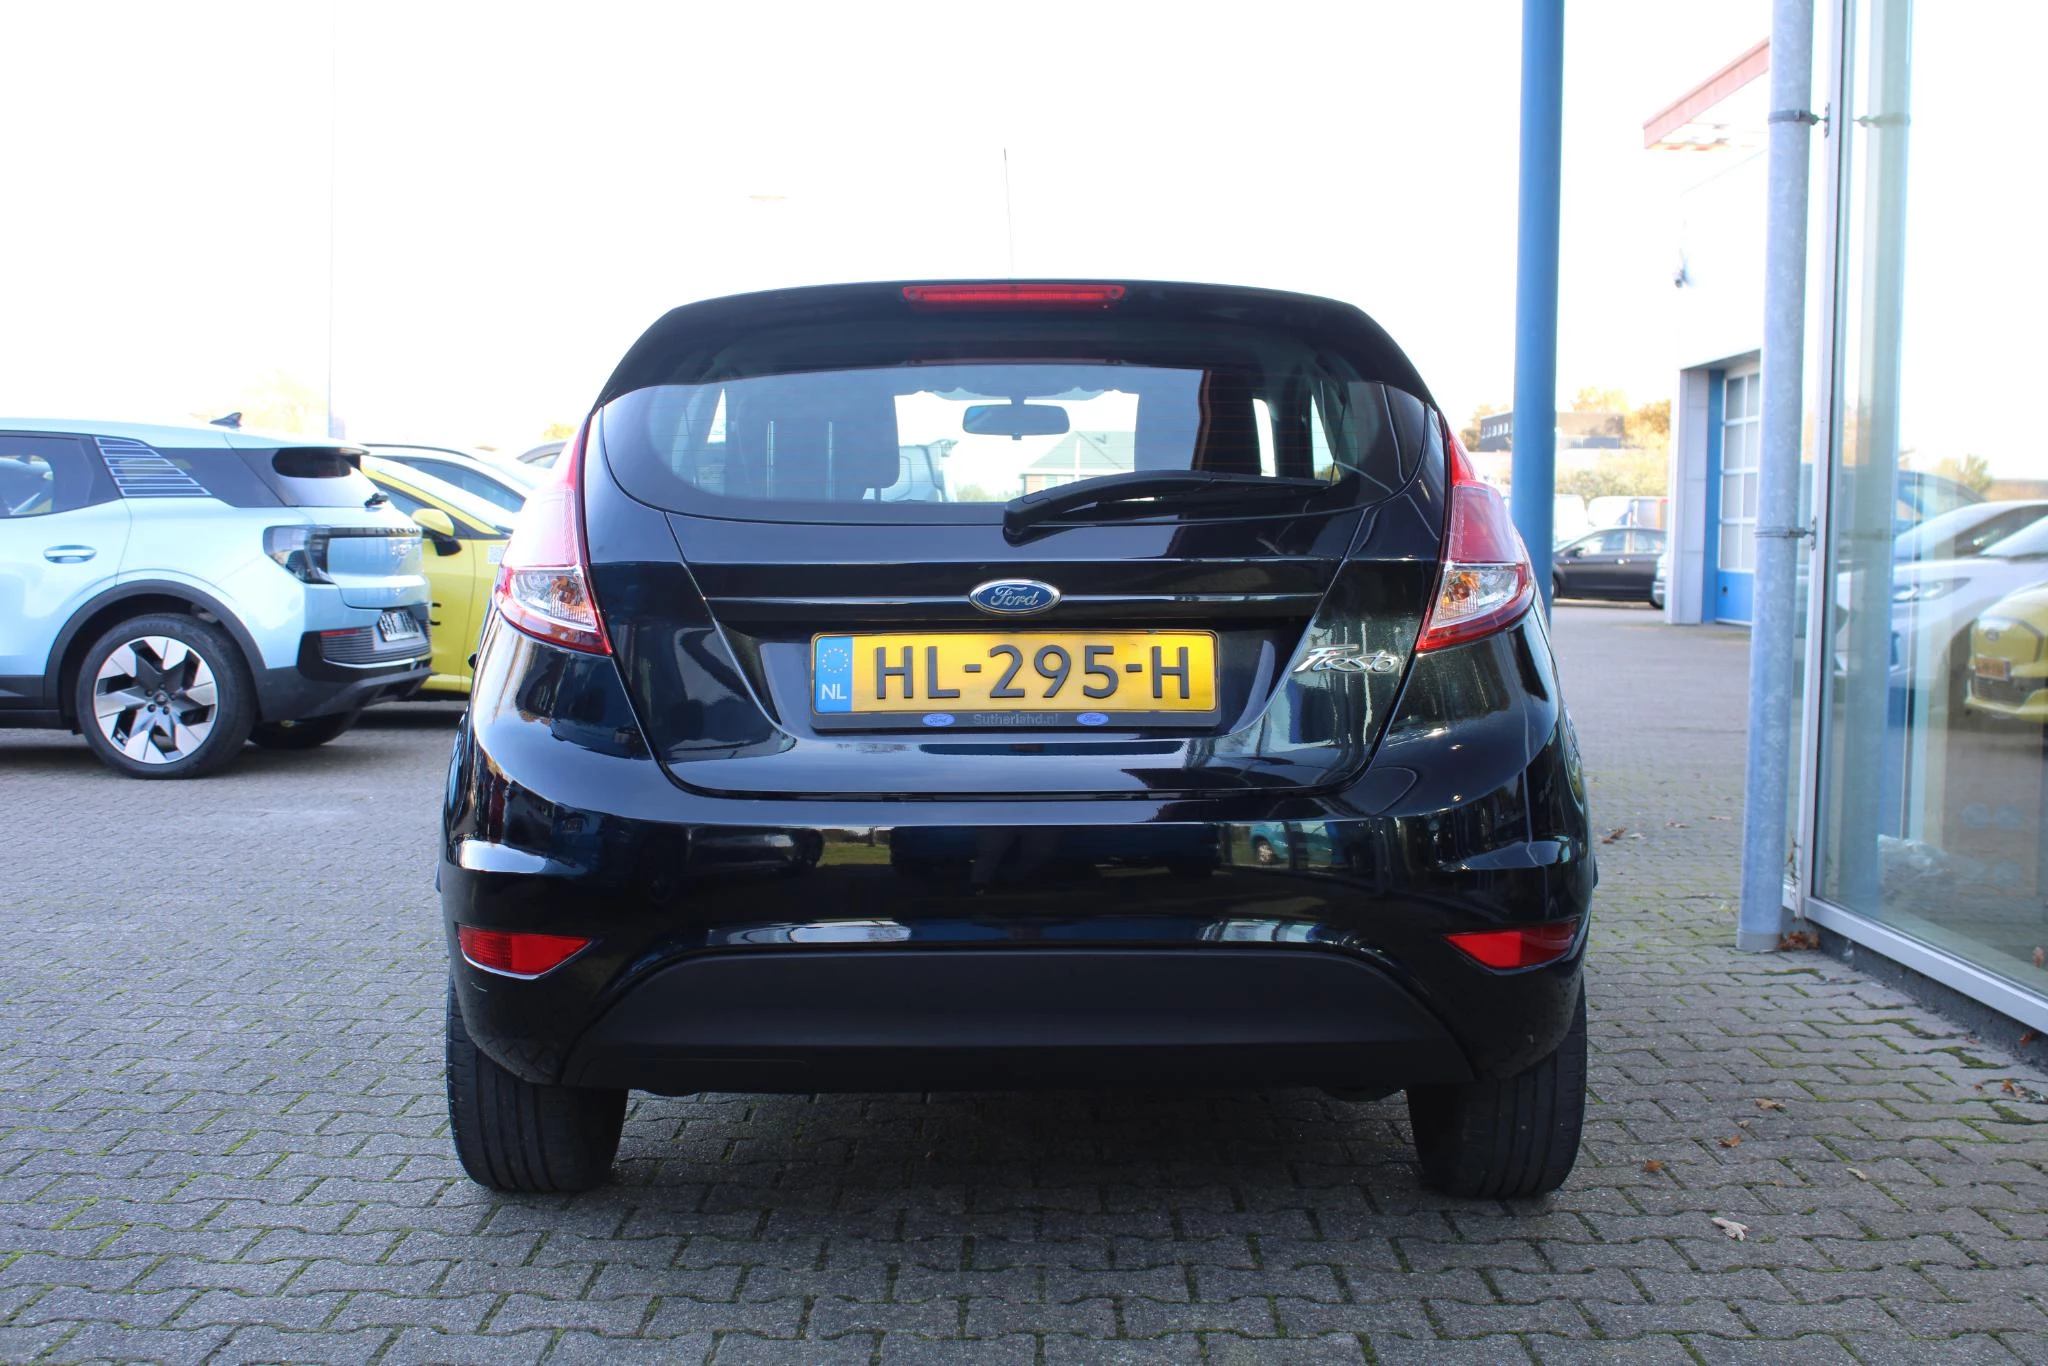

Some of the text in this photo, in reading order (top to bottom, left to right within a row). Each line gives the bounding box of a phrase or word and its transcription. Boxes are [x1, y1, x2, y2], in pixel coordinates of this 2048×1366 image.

[990, 585, 1040, 606] Ford
[1293, 643, 1399, 673] Fiesta
[875, 643, 1191, 700] HL-295-H
[820, 683, 848, 701] NL
